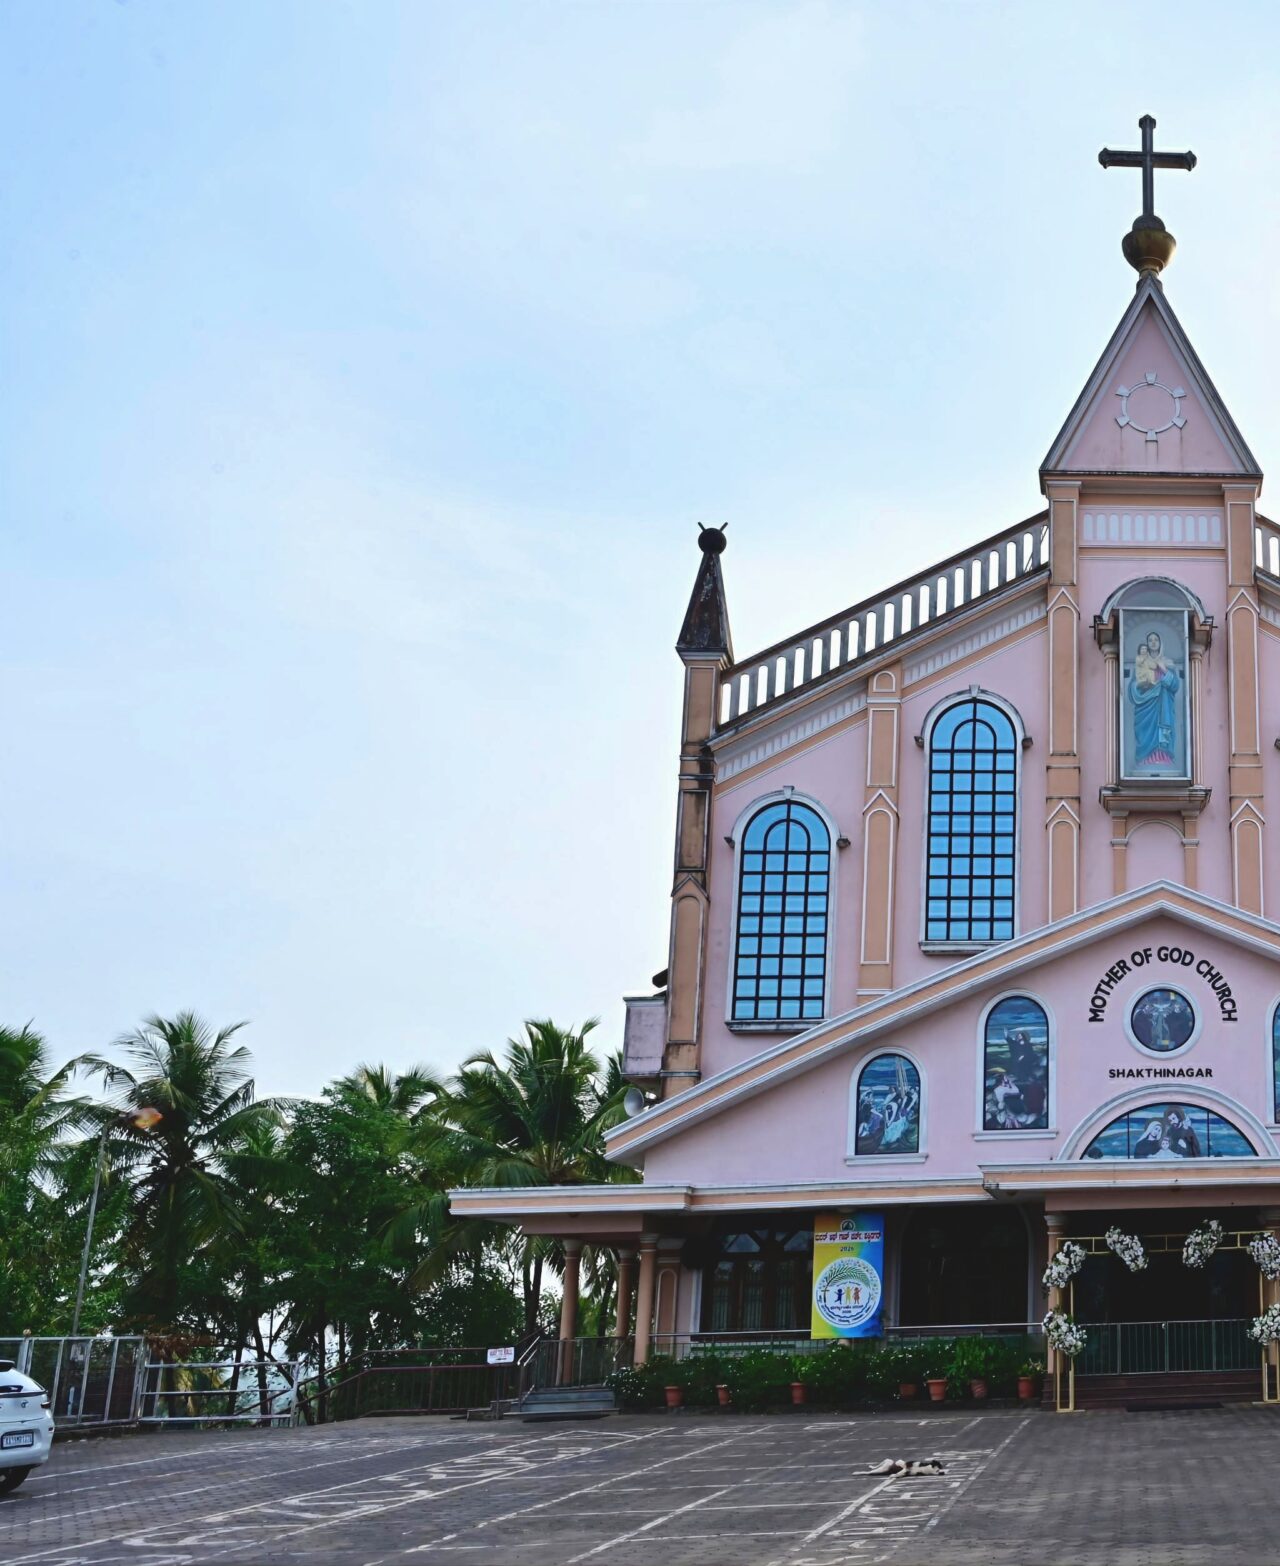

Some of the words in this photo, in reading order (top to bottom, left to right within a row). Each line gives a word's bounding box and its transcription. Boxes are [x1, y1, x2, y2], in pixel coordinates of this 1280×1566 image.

[1088, 959, 1132, 1023] MOTHER
[1130, 947, 1153, 967] OF
[1157, 946, 1195, 967] GOD
[1195, 959, 1238, 1022] CHURCH
[1108, 1068, 1213, 1079] SHAKTHINAGAR
